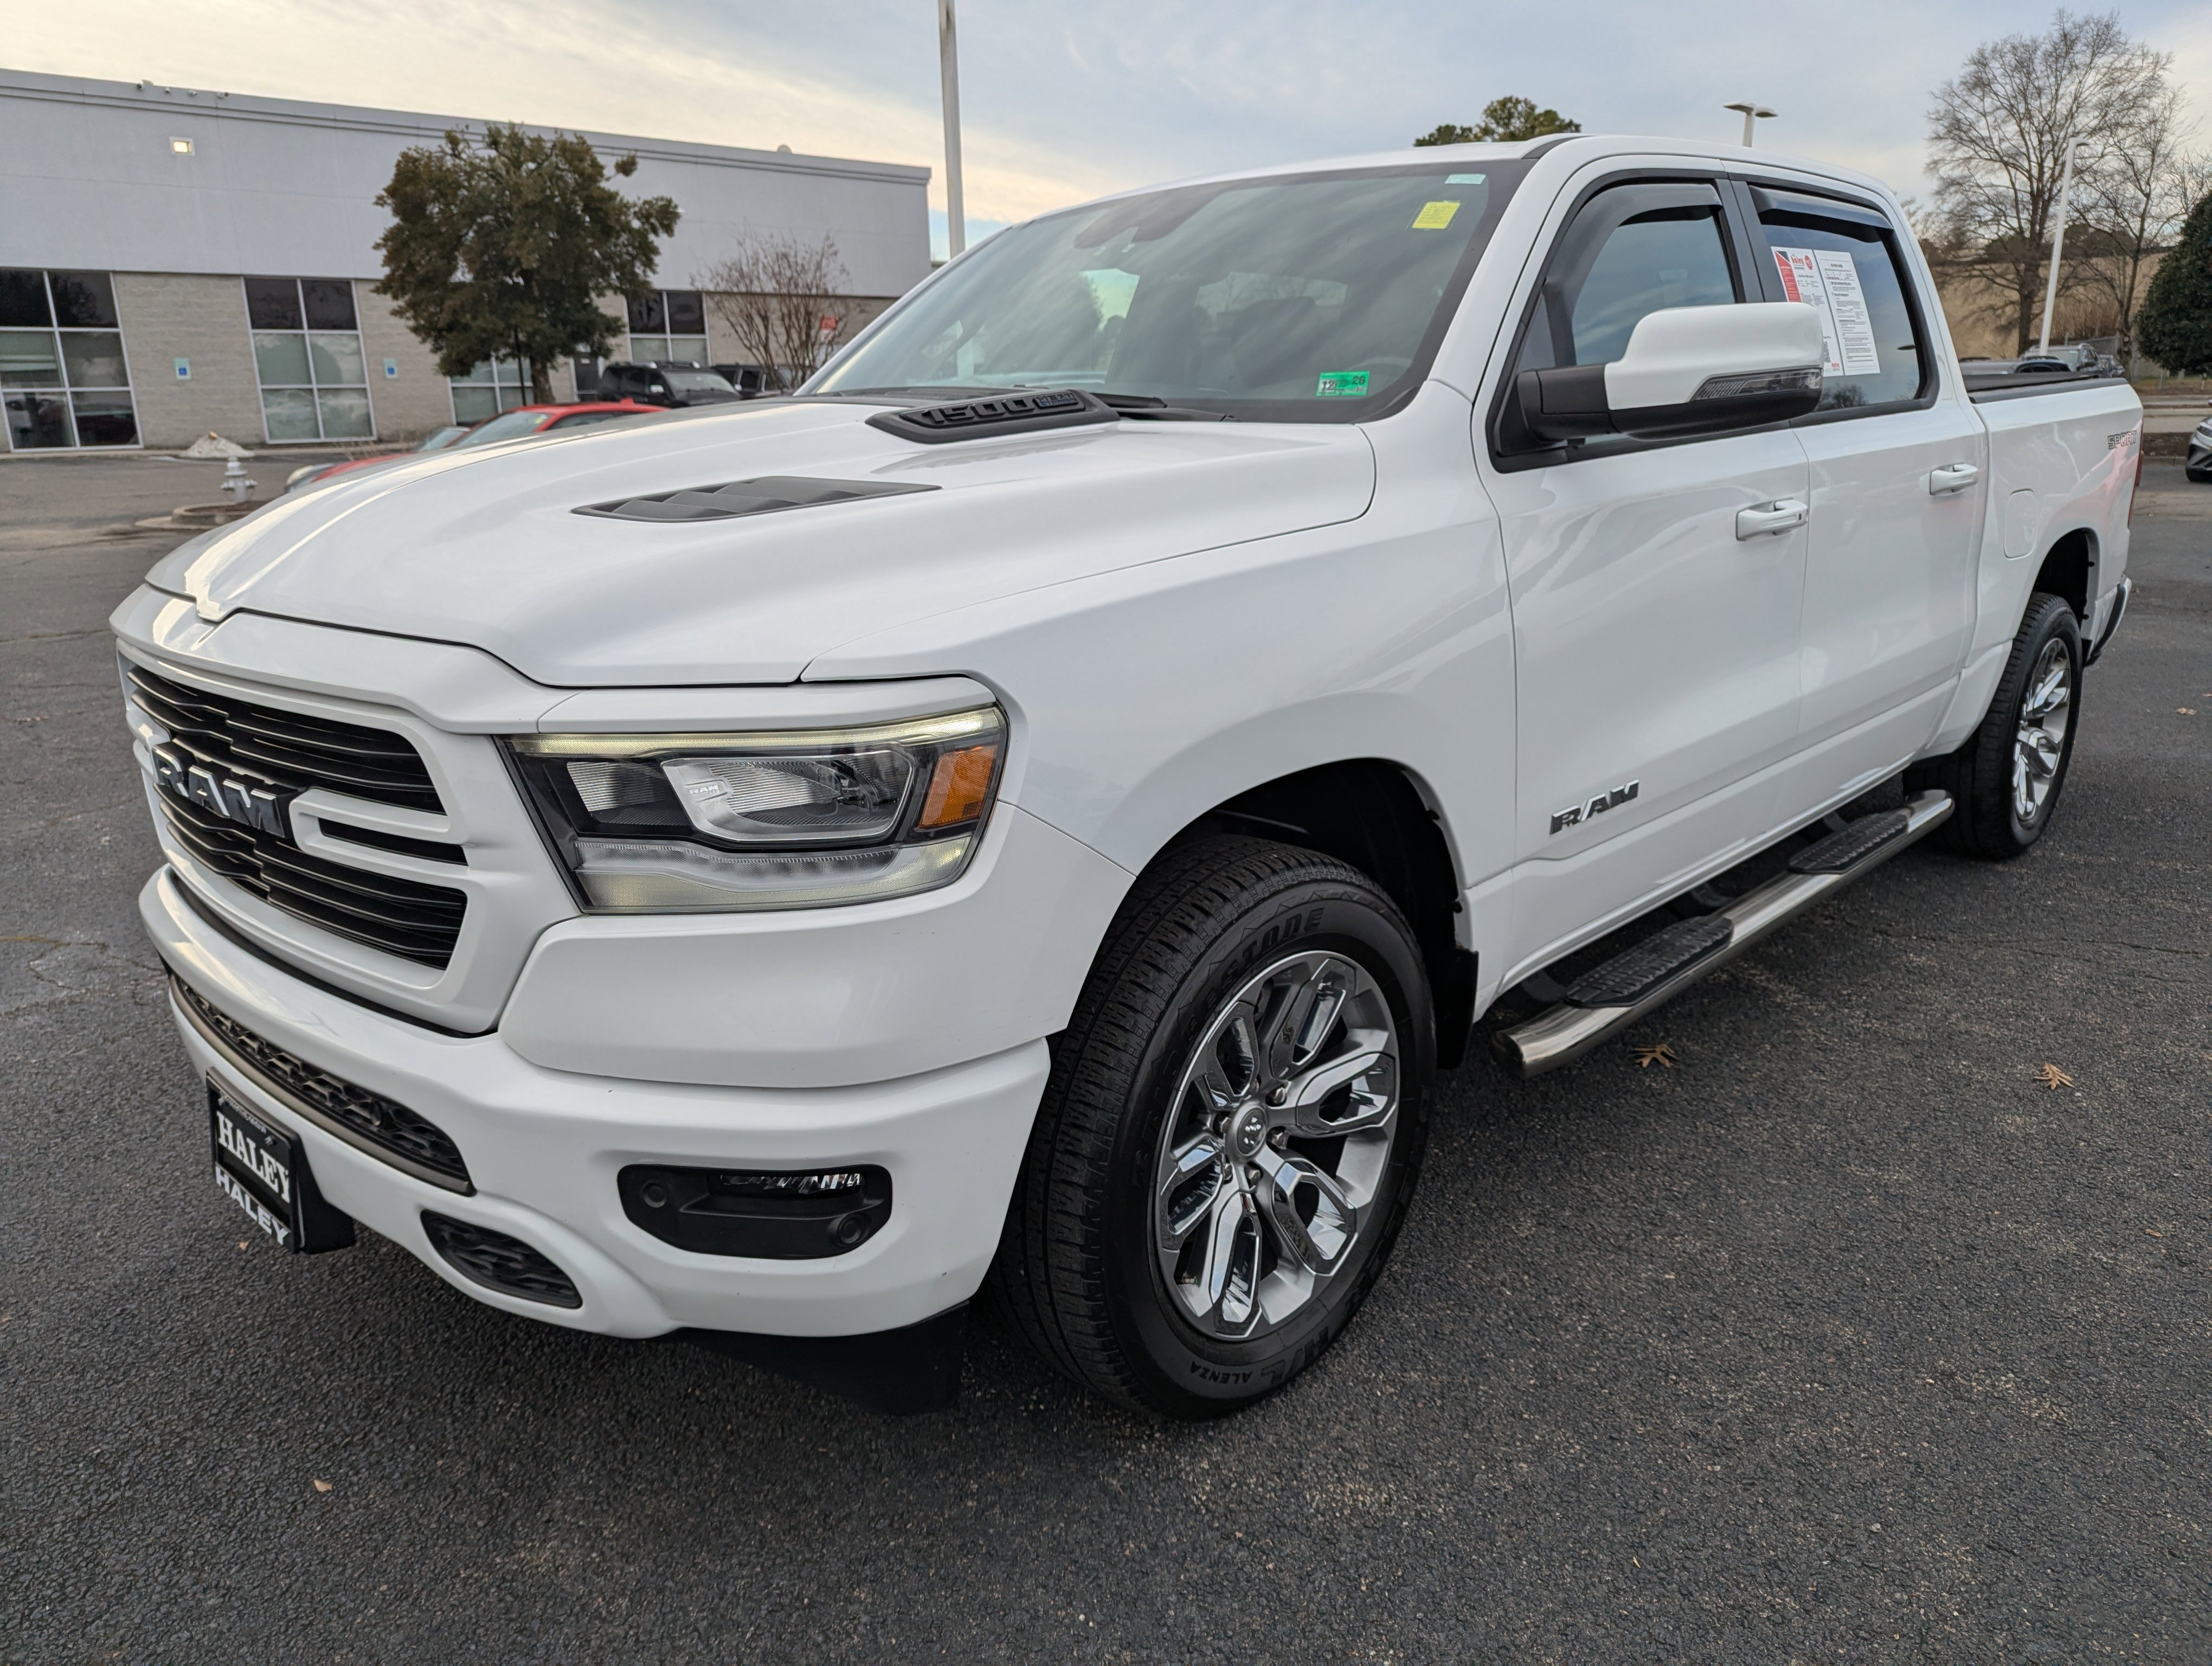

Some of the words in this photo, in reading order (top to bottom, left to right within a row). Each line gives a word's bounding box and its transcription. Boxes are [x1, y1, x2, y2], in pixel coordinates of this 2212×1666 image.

[1321, 380, 1335, 391] 12
[922, 398, 1035, 423] 1500
[2107, 430, 2137, 450] SPORT
[152, 746, 286, 838] RAM
[689, 785, 719, 794] RAM
[1549, 779, 1639, 835] RAM
[217, 1111, 290, 1203] HALEY
[216, 1166, 290, 1246] HALEY
[1189, 1360, 1253, 1384] ALENZA
